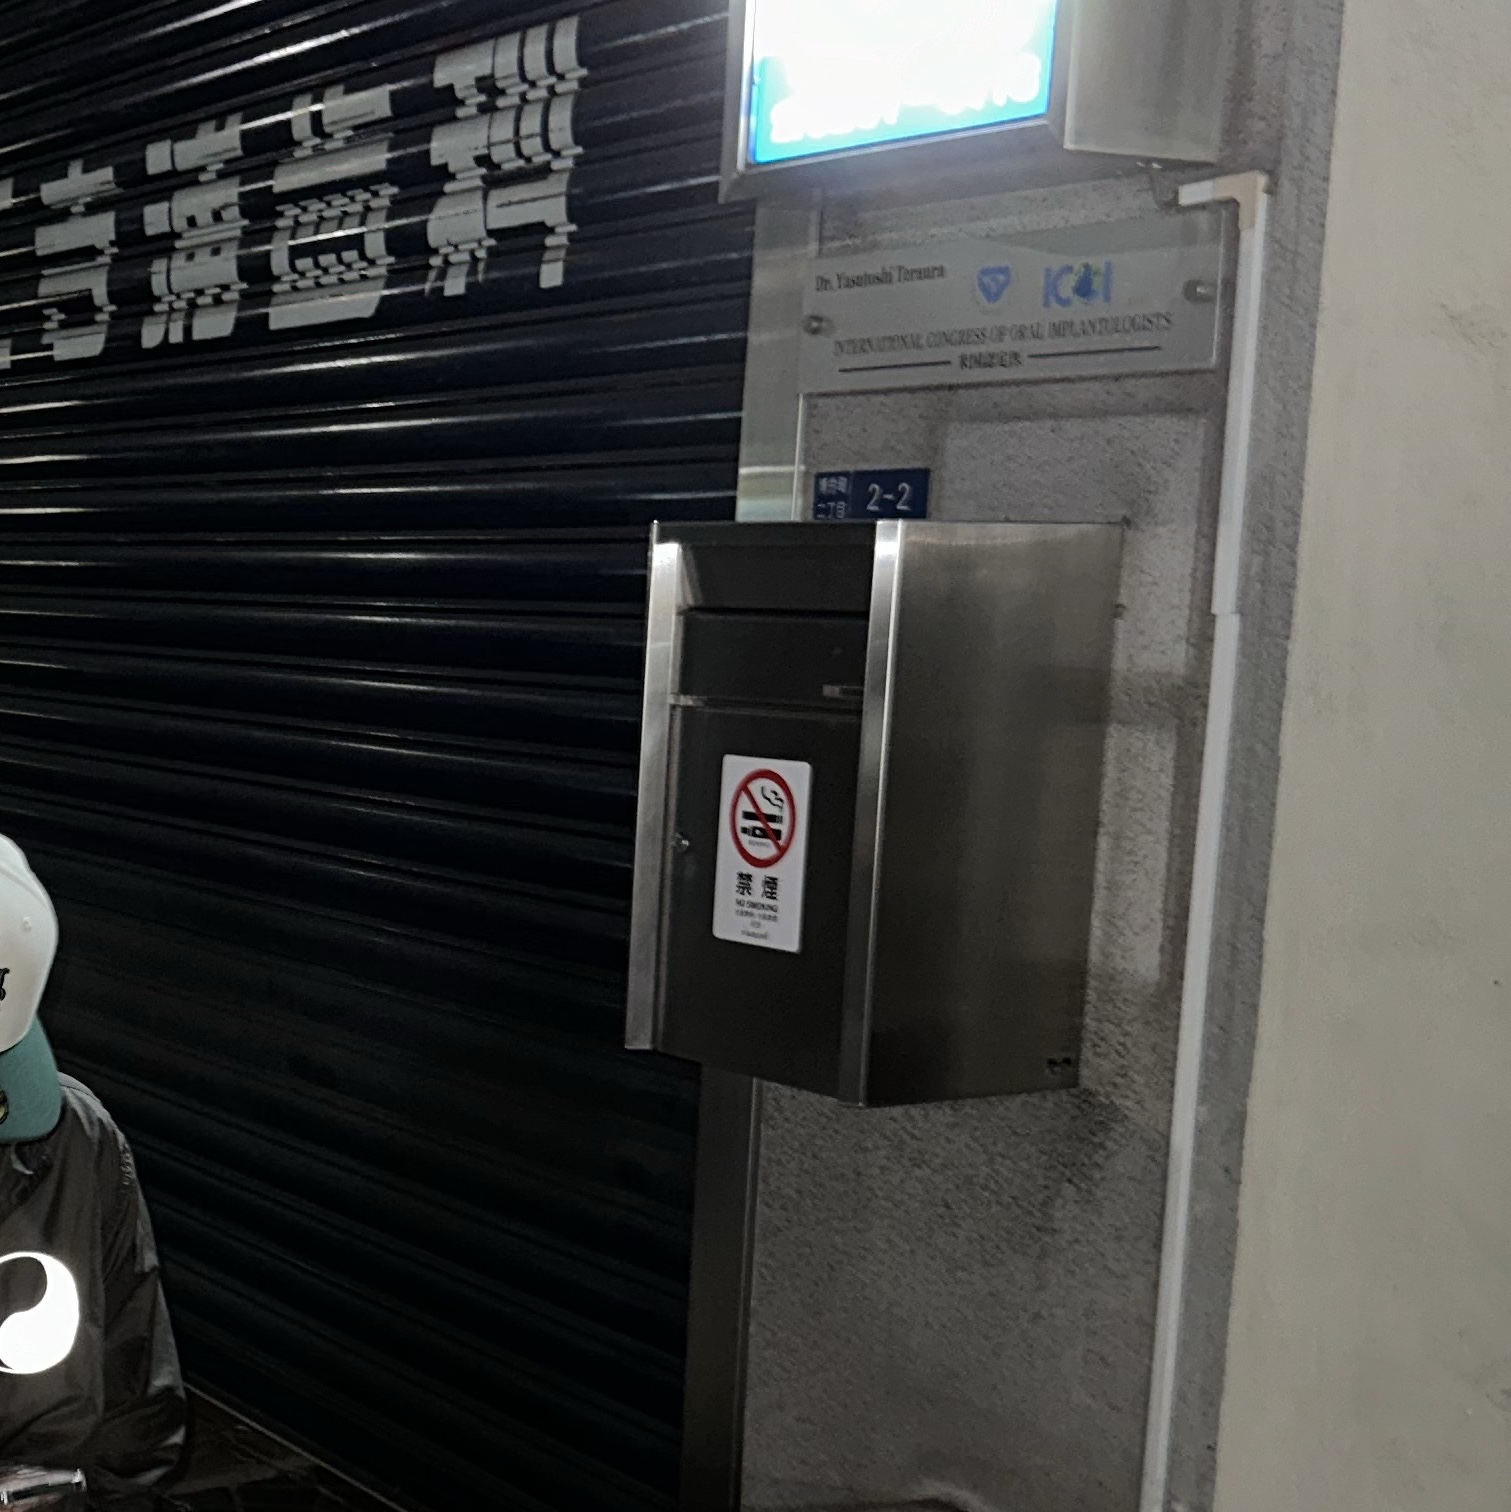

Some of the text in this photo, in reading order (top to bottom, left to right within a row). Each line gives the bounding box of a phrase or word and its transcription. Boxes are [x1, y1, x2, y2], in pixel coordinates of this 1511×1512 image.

[926, 326, 987, 350] CONGRESS
[989, 325, 1008, 344] OF
[866, 481, 912, 511] 2-2
[747, 900, 779, 913] SMOKING
